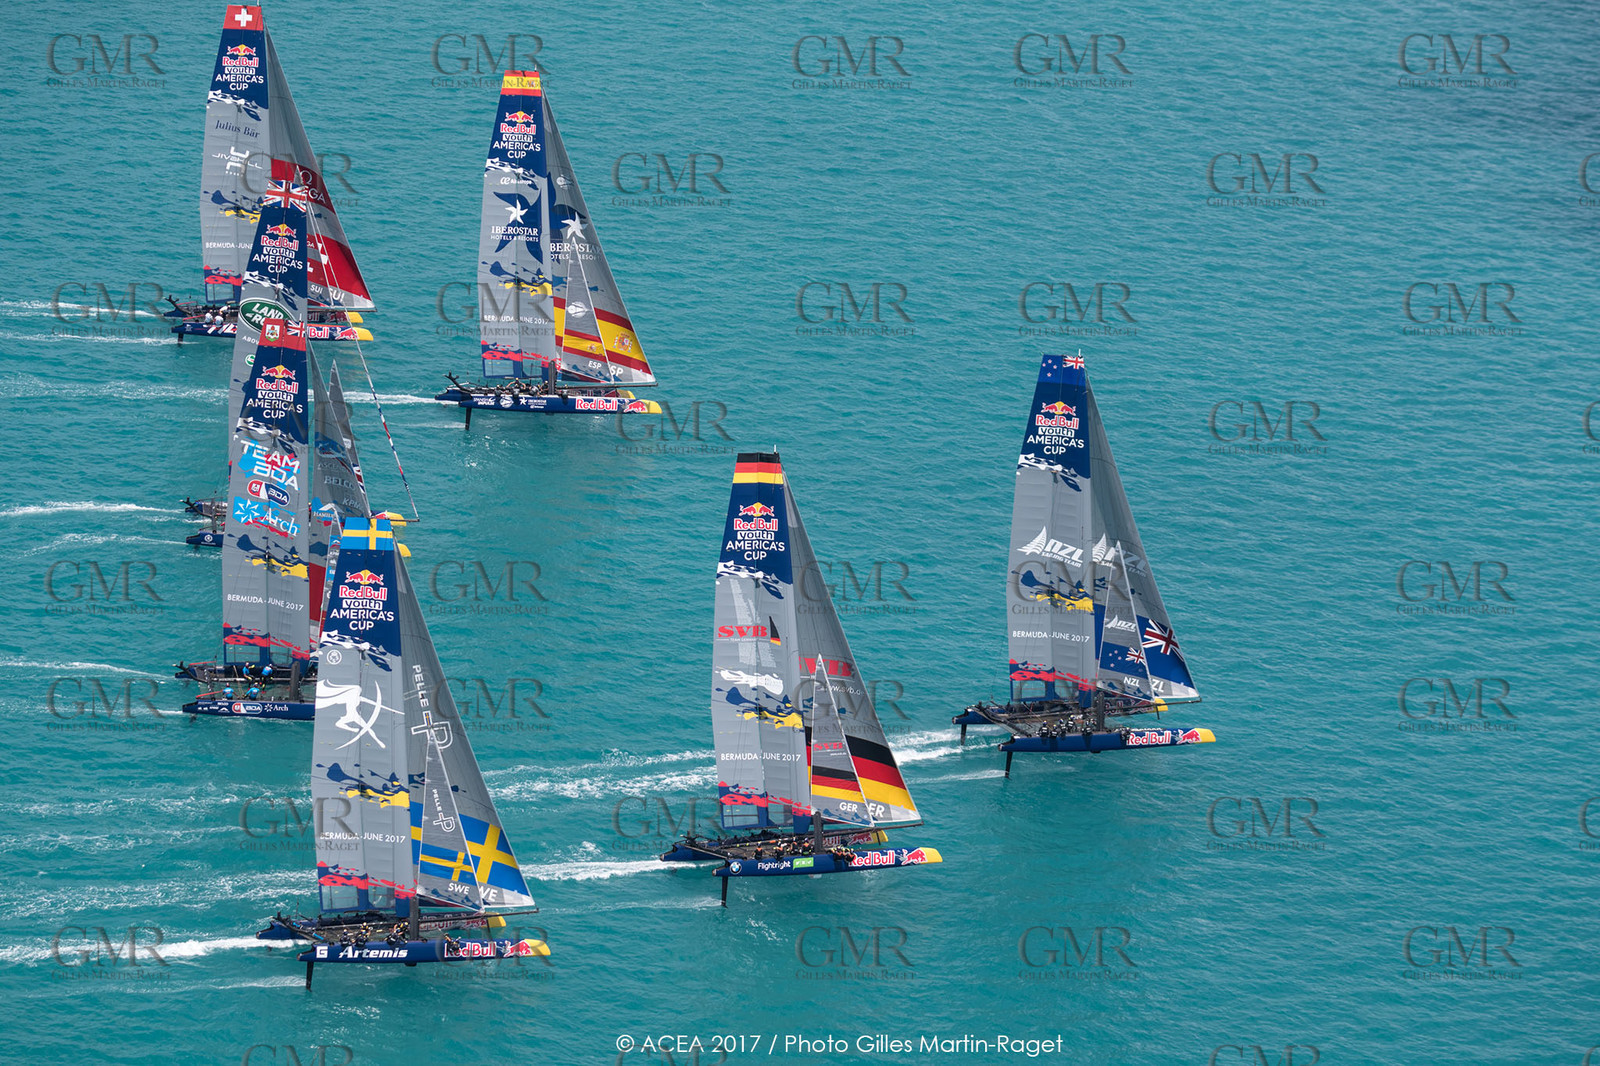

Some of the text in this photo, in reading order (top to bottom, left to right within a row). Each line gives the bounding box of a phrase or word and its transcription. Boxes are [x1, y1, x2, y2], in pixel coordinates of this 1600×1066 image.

[216, 74, 264, 84] AMERICA'S
[216, 120, 260, 138] Julius Bär
[503, 134, 533, 142] youth
[493, 141, 541, 151] AMERICA'S
[492, 226, 538, 236] IBEROSTAR
[252, 254, 303, 270] AMERICA'S
[268, 264, 288, 274] CUP
[310, 284, 323, 294] SUI
[252, 302, 283, 319] LAND
[588, 361, 602, 369] ESP
[258, 390, 294, 402] youth
[246, 398, 303, 413] AMERICAS
[576, 398, 618, 411] Red Bull
[263, 410, 285, 418] CUP
[1038, 426, 1075, 437] youth
[1027, 435, 1084, 448] AMERICA'S
[1044, 446, 1066, 455] CUP
[241, 440, 300, 474] TEAM
[253, 461, 298, 491] BDA
[261, 508, 298, 536] Arch
[737, 531, 774, 540] youth
[726, 540, 785, 551] AMERICA'S
[744, 551, 767, 560] CUP
[227, 594, 304, 611] BERMUDA JUNE 2017
[342, 599, 383, 610] youth
[330, 609, 394, 621] AMERICA'S
[349, 621, 374, 630] CUP
[718, 625, 768, 638] SVB
[1052, 632, 1069, 640] JUNE
[1071, 634, 1090, 643] 2017
[413, 664, 429, 707] PELLE
[1124, 676, 1139, 687] NZL
[1151, 679, 1164, 692] ZL
[1150, 732, 1171, 744] Bull
[814, 742, 844, 751] SVB
[721, 753, 801, 762] BERMUDA JUNE 2017
[432, 789, 442, 812] PELLE
[839, 802, 858, 813] GER
[868, 803, 885, 818] ER
[362, 832, 383, 842] JUNE
[385, 834, 406, 843] 2017
[873, 852, 895, 865] Bull
[757, 860, 791, 871] Flightright
[448, 883, 470, 895] SWE
[339, 946, 408, 958] Artemis
[472, 942, 496, 957] Bull
